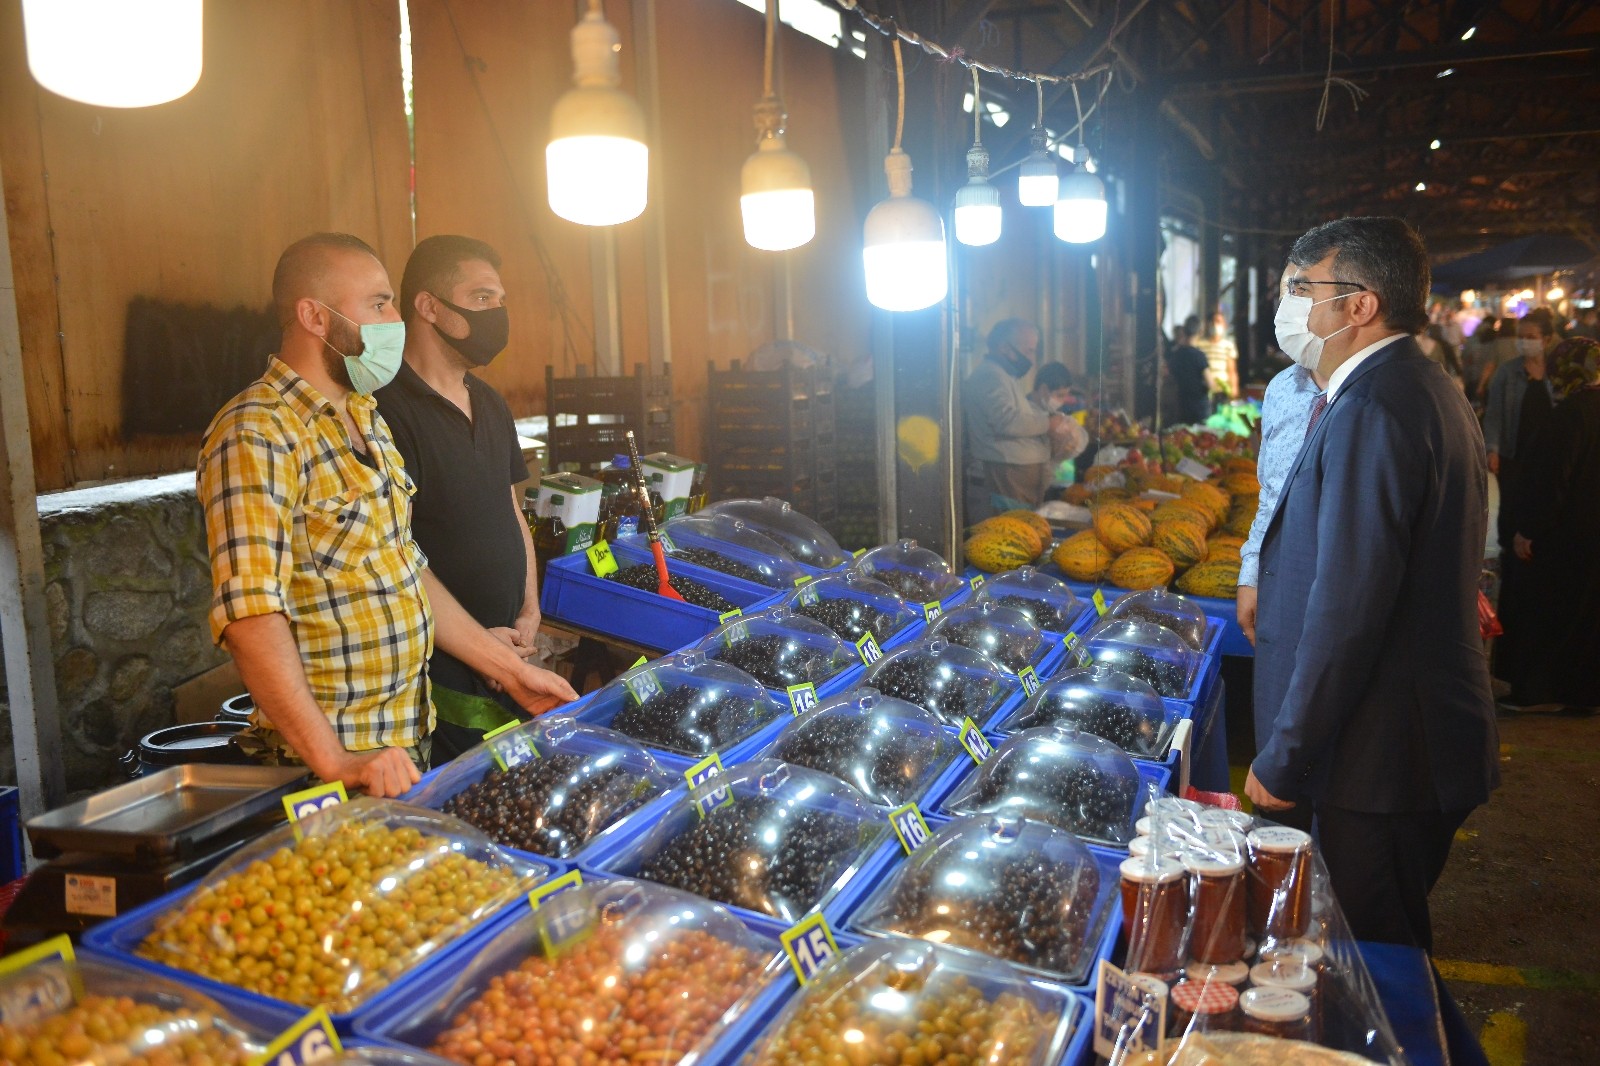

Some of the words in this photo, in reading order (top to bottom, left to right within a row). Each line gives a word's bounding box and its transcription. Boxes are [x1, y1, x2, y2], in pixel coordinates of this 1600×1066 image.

[863, 640, 881, 664] 18
[796, 691, 816, 713] 16
[497, 732, 532, 768] 24
[966, 728, 990, 761] 12
[900, 811, 926, 849] 16
[797, 927, 834, 974] 15
